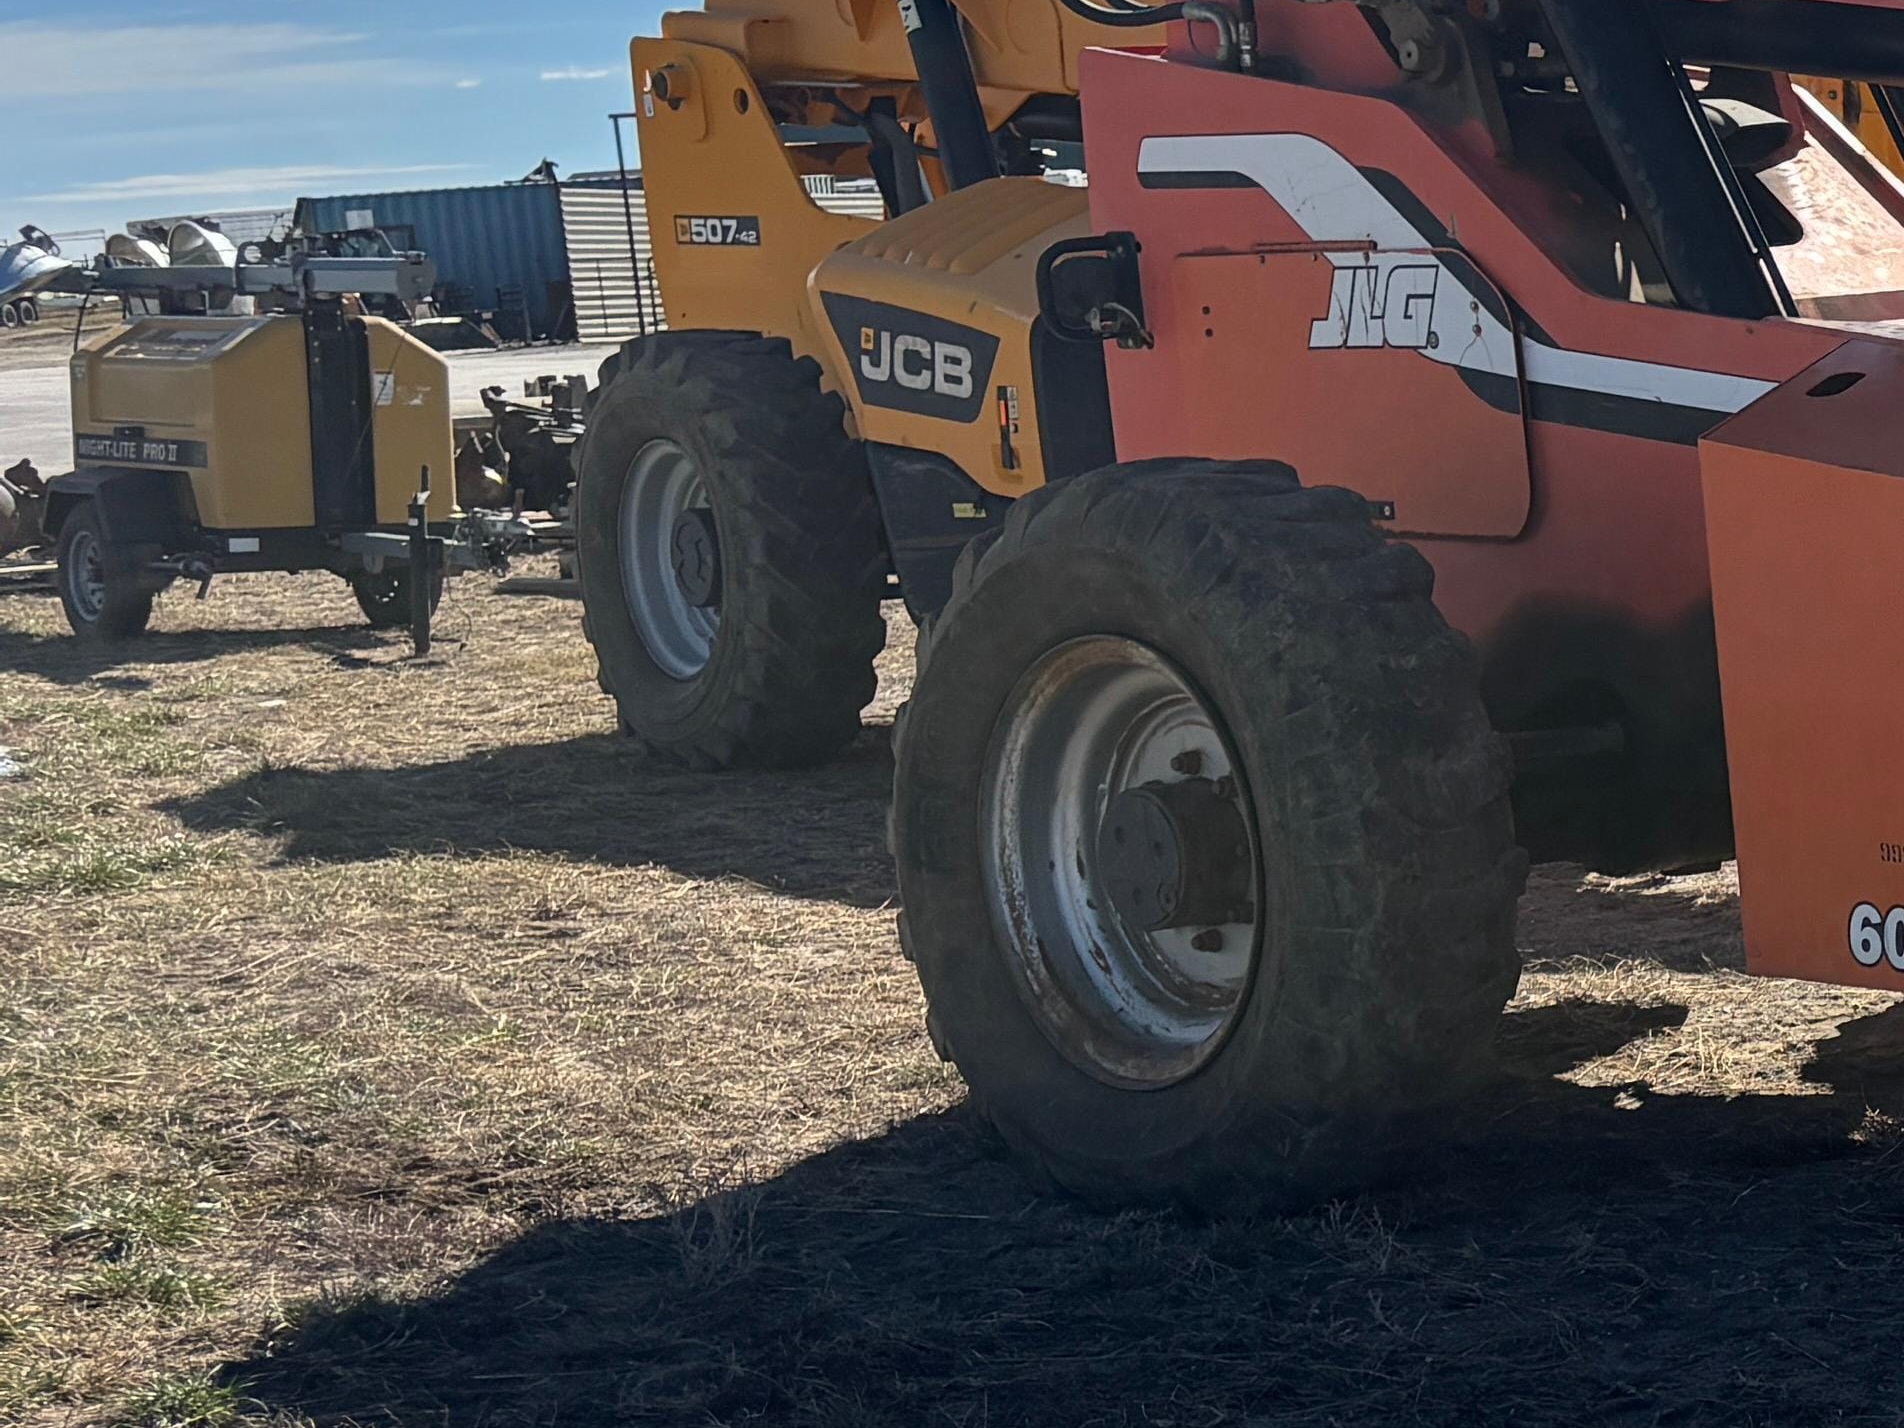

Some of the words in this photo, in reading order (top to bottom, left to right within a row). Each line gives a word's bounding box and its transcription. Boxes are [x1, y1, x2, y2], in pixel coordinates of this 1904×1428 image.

[1307, 264, 1440, 349] JLG
[860, 329, 974, 399] JCB
[143, 442, 166, 461] PRO
